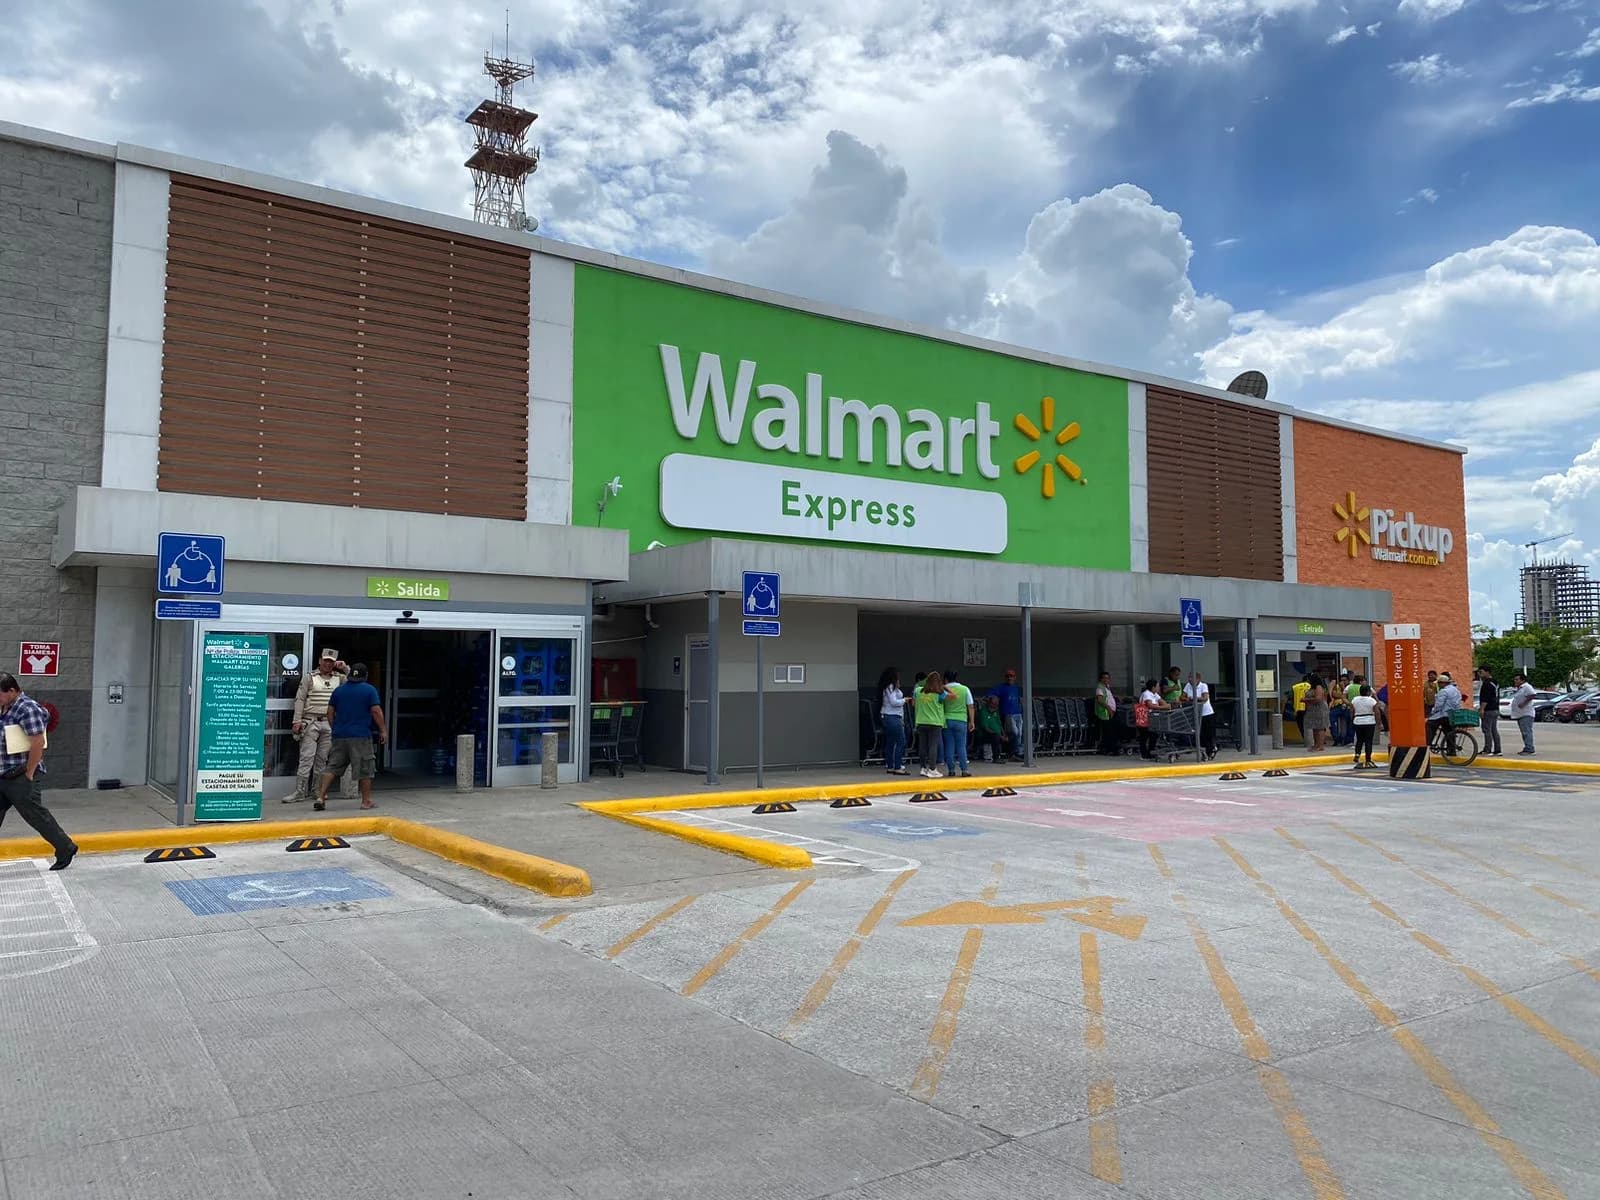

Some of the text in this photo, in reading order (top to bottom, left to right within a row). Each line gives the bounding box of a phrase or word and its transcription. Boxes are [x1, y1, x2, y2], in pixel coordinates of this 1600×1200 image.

[658, 343, 1000, 479] Walmart
[781, 480, 916, 530] Express
[1370, 508, 1453, 563] Pickup
[397, 581, 440, 597] Salida
[1304, 624, 1324, 633] Entrada
[1393, 627, 1398, 635] 1
[1394, 644, 1404, 679] Pickup
